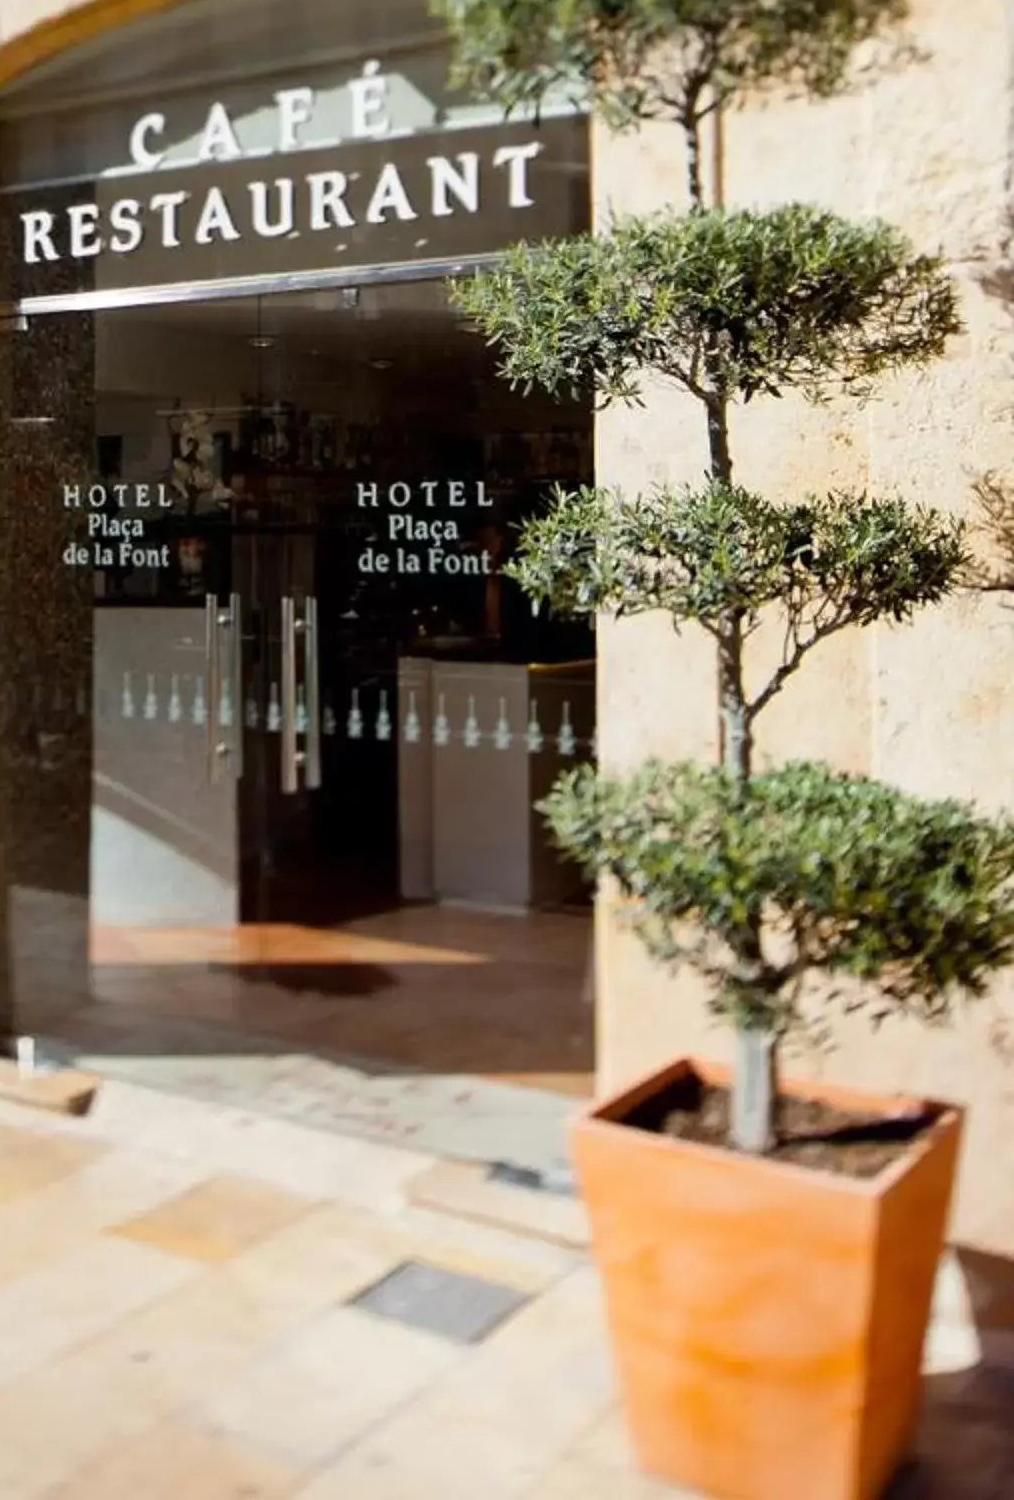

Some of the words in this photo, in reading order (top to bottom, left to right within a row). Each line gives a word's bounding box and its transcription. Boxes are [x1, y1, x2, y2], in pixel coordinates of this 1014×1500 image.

[129, 60, 392, 168] CAFÉ
[20, 141, 544, 264] RESTAURANT
[63, 483, 173, 508] HOTEL
[356, 481, 494, 508] HOTEL
[88, 513, 144, 543] Plaça
[388, 514, 459, 547] Plaça
[63, 542, 89, 566] de
[94, 542, 114, 566] la
[119, 542, 171, 568] Font
[357, 547, 390, 573] de
[397, 547, 421, 574] la
[428, 547, 492, 575] Font
